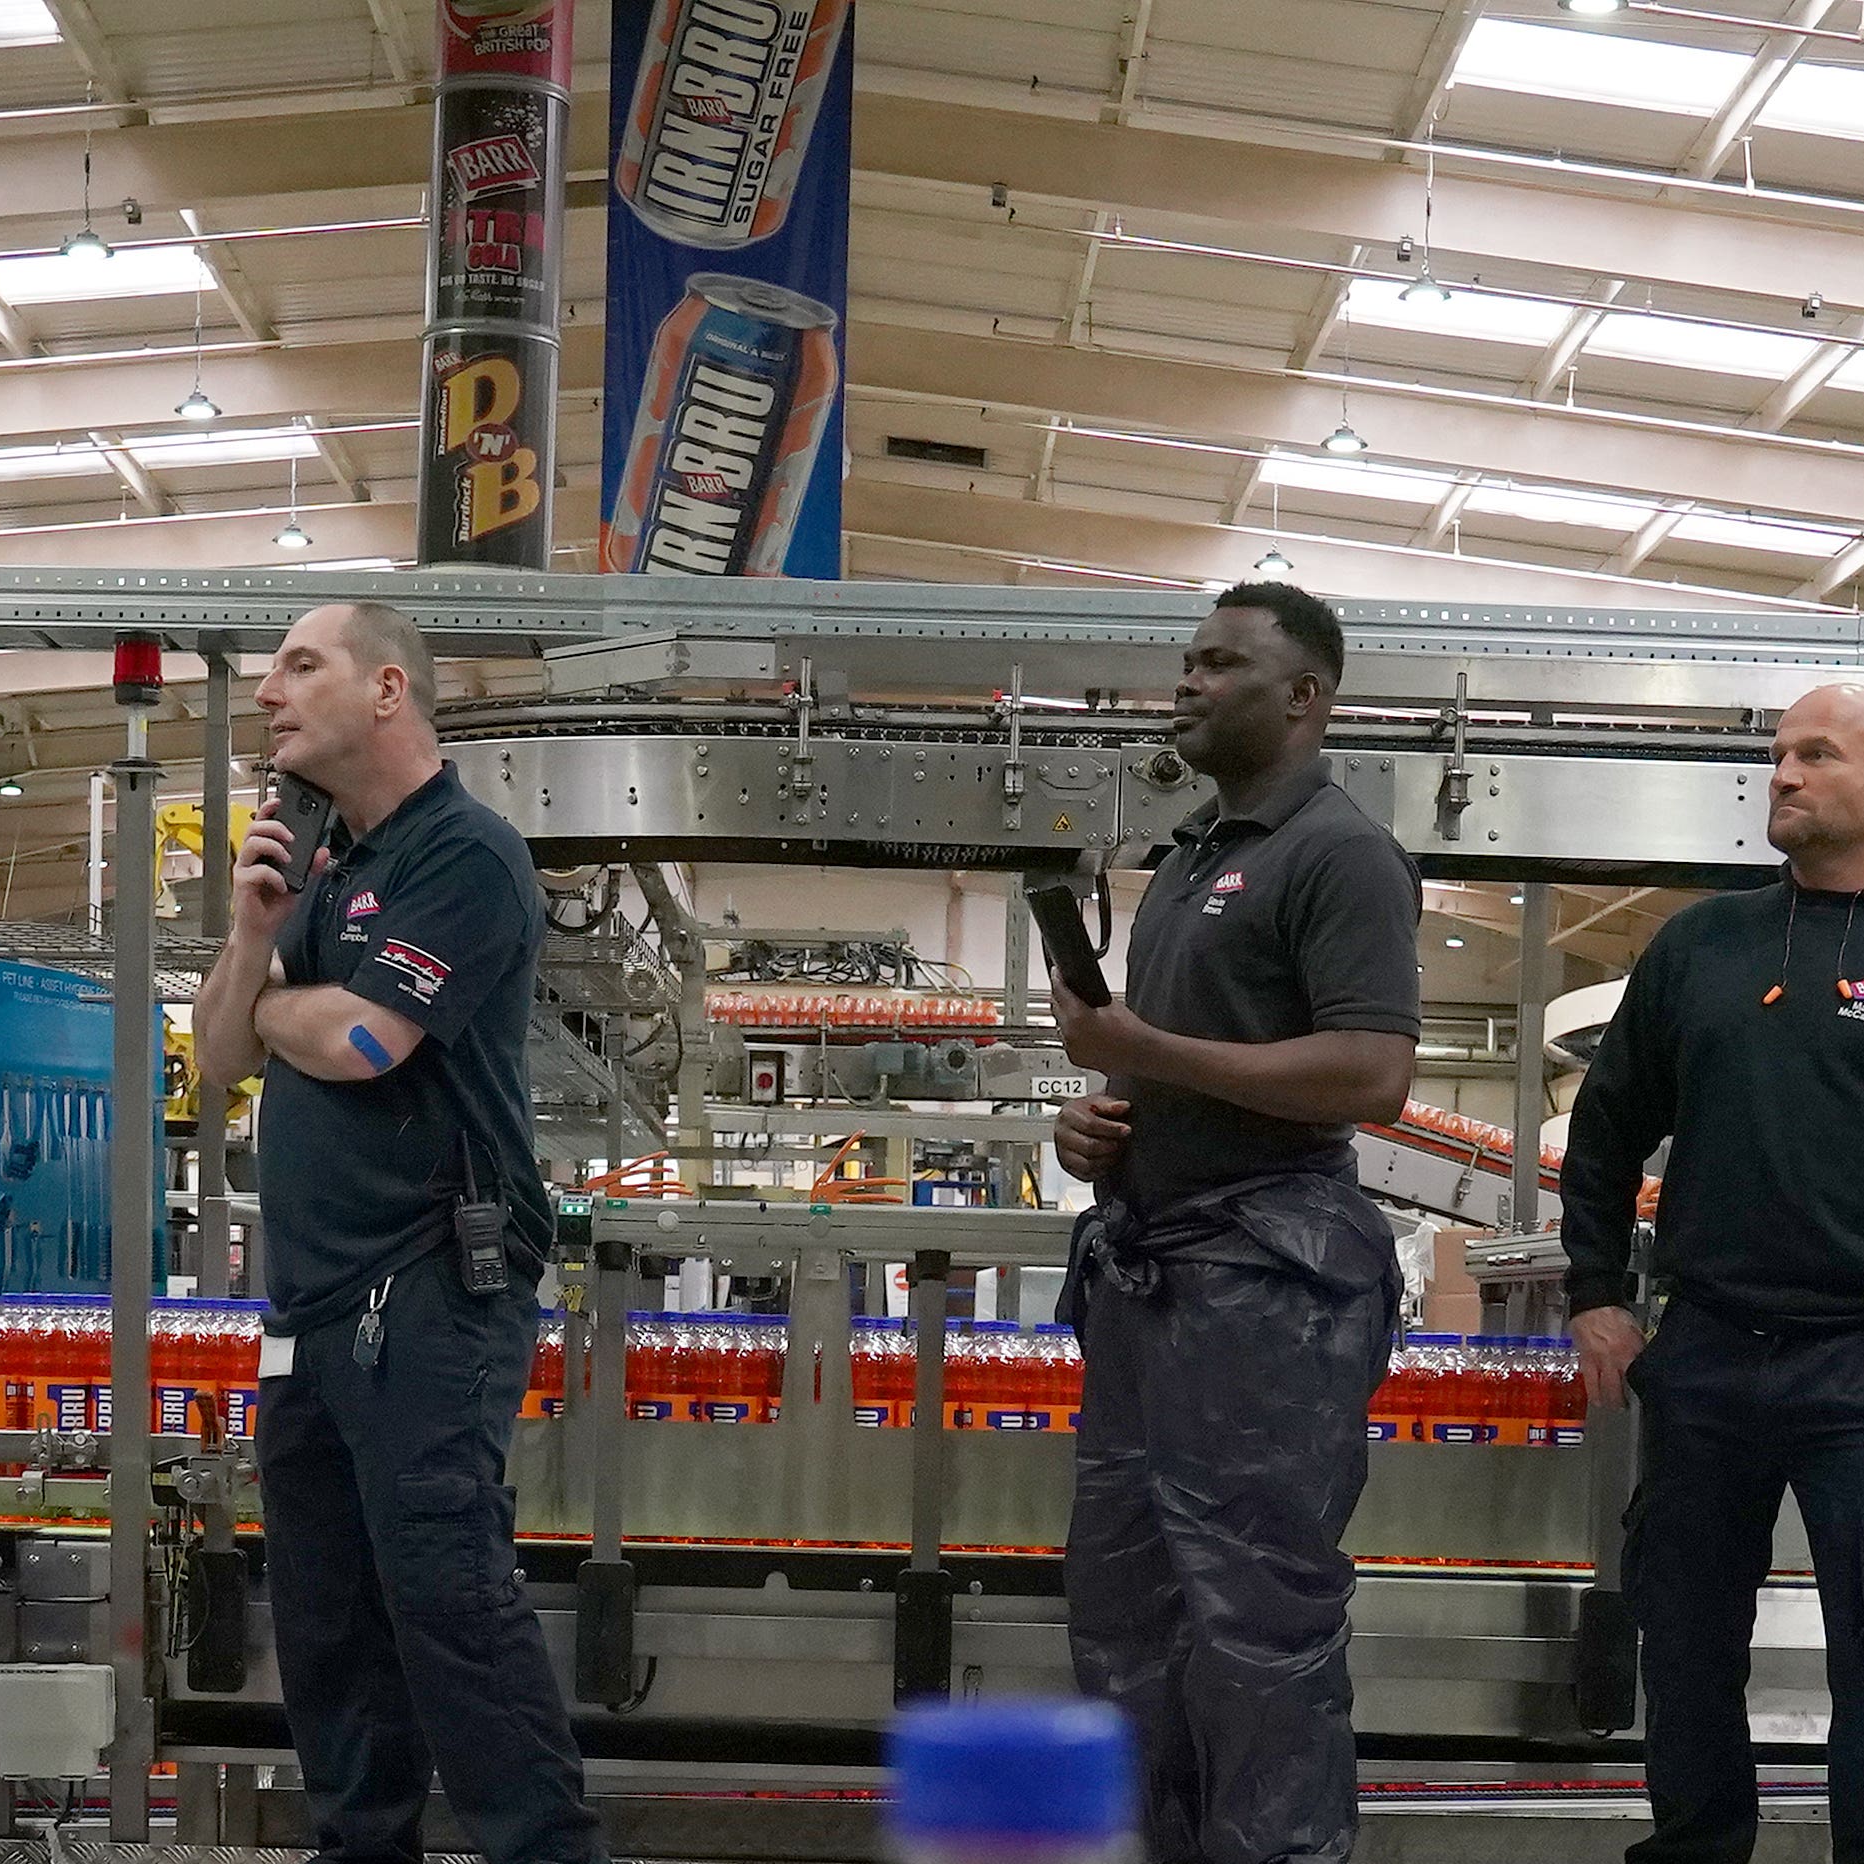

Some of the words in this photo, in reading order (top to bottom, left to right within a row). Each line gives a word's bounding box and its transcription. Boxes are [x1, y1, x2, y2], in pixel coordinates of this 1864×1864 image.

[672, 0, 779, 116] BRU
[687, 98, 729, 118] BARR
[734, 113, 779, 224] SUGAR
[768, 11, 809, 100] FREE
[460, 142, 530, 182] BARR
[646, 111, 748, 220] IRN
[671, 364, 776, 491] BRU
[688, 474, 729, 495] BARR
[458, 477, 473, 543] Burdock
[1215, 872, 1244, 889] BARR
[350, 891, 380, 913] BARR
[1038, 1080, 1082, 1094] CC12
[60, 1388, 86, 1428] BRU
[163, 1390, 185, 1425] BRU
[227, 1392, 245, 1433] BRU
